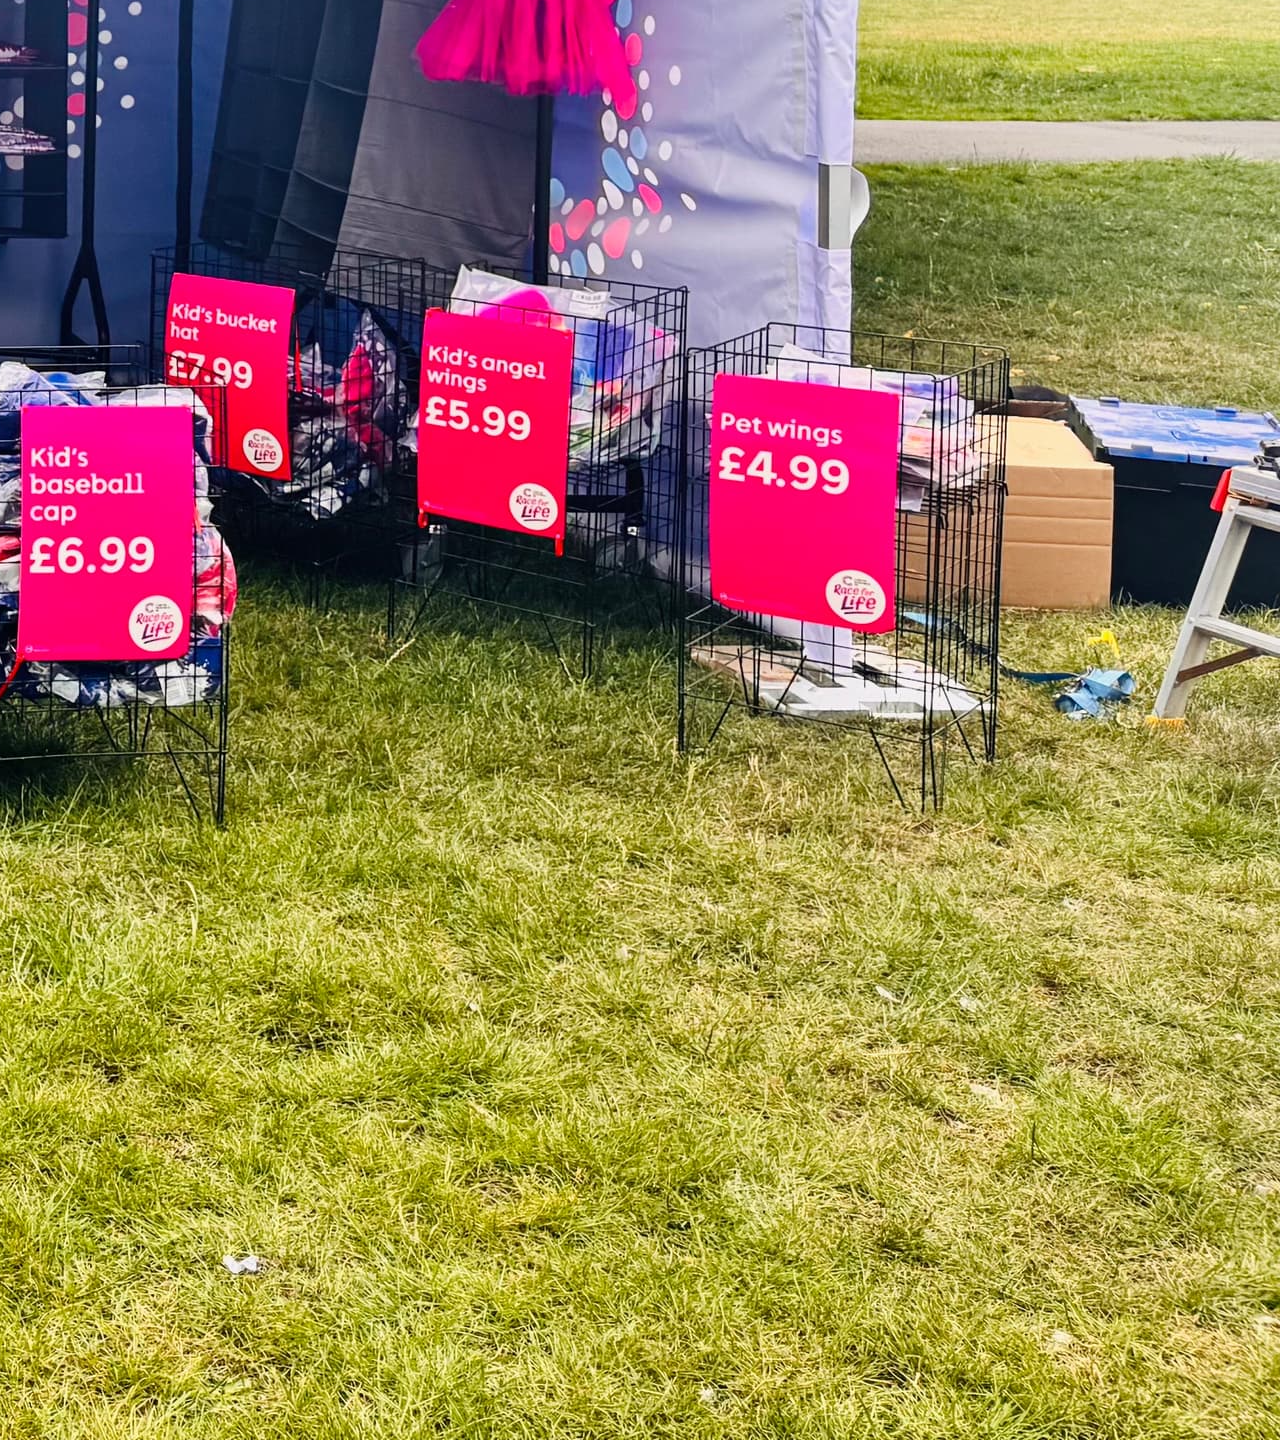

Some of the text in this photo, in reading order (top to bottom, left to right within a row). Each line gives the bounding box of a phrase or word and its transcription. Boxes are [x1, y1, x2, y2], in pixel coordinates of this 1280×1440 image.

[172, 303, 277, 333] Kid's bucket
[169, 323, 199, 341] hat
[168, 350, 253, 389] £7.99
[428, 345, 547, 380] Kid's angel
[426, 369, 487, 393] wings
[425, 396, 531, 441] £5.99
[720, 412, 843, 448] Pet wings
[31, 446, 89, 468] Kid's
[254, 449, 277, 461] Life
[718, 446, 850, 495] £4.99
[29, 472, 145, 494] baseball
[29, 505, 78, 526] cap
[521, 505, 551, 518] Life
[29, 536, 155, 574] £6.99
[833, 583, 860, 596] Race
[840, 594, 877, 611] Life
[141, 621, 175, 640] Life
